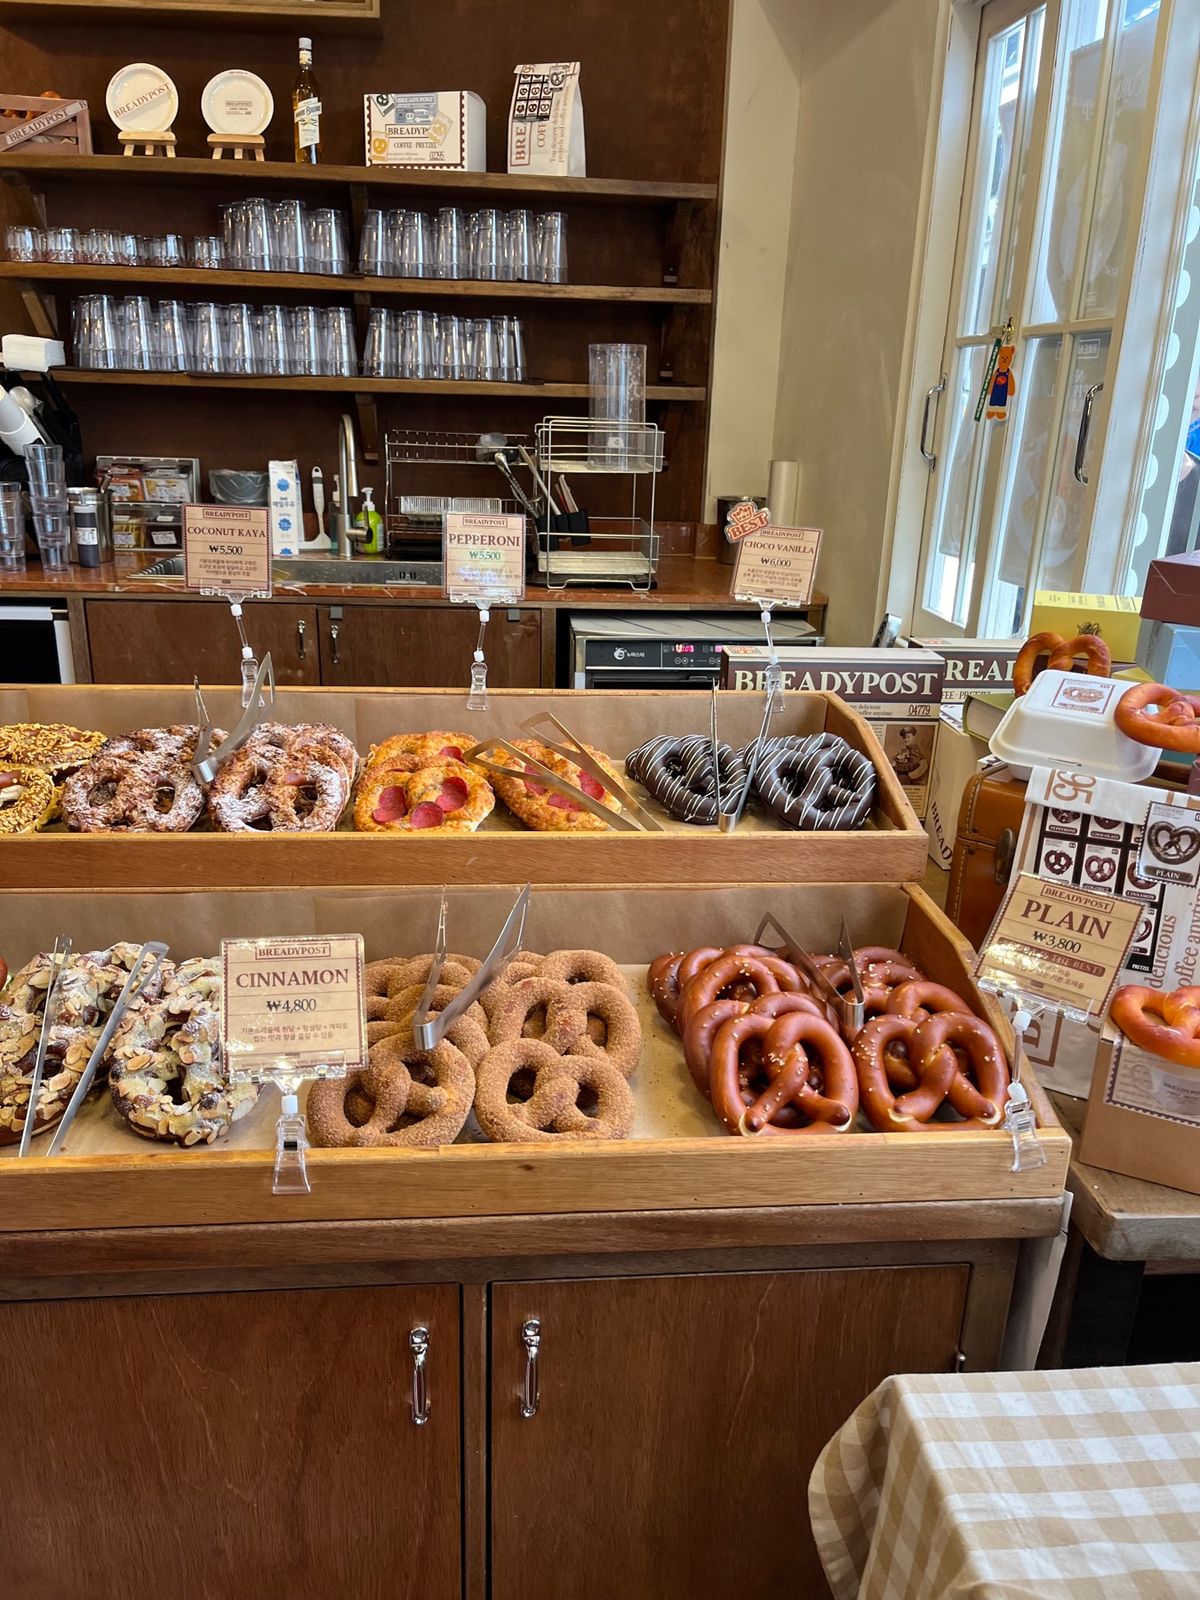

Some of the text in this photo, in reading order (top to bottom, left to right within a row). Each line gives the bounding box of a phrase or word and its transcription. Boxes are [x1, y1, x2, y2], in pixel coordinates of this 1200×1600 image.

[113, 83, 171, 118] BREADYPOST
[9, 109, 69, 142] BREADYPOST
[515, 124, 527, 160] BRE
[205, 511, 249, 519] BREADYPOST
[464, 518, 506, 526] BREADYPOST
[187, 526, 266, 538] COCONUT KAYA
[730, 515, 767, 538] BEST
[762, 530, 802, 539] BREADYPOST
[449, 533, 520, 547] PEPPERONI
[744, 540, 814, 555] CHOCO VANILLA
[209, 545, 243, 556] ₩5,500
[760, 557, 791, 568] ₩6,000
[943, 660, 1016, 680] REA
[734, 670, 938, 695] BREADYPOST
[908, 704, 931, 716] 04779
[931, 802, 953, 866] BREAD
[1155, 869, 1180, 880] PLAIN
[1045, 888, 1110, 911] BREADYPOST
[1020, 898, 1112, 940] PLAIN
[258, 946, 328, 957] BREADYPOST
[1032, 931, 1082, 954] ₩3,800
[1144, 914, 1176, 989] delicious
[1051, 952, 1070, 966] THE
[1174, 946, 1199, 987] offee
[236, 968, 349, 988] CINNAMON
[266, 998, 317, 1014] ₩4,800
